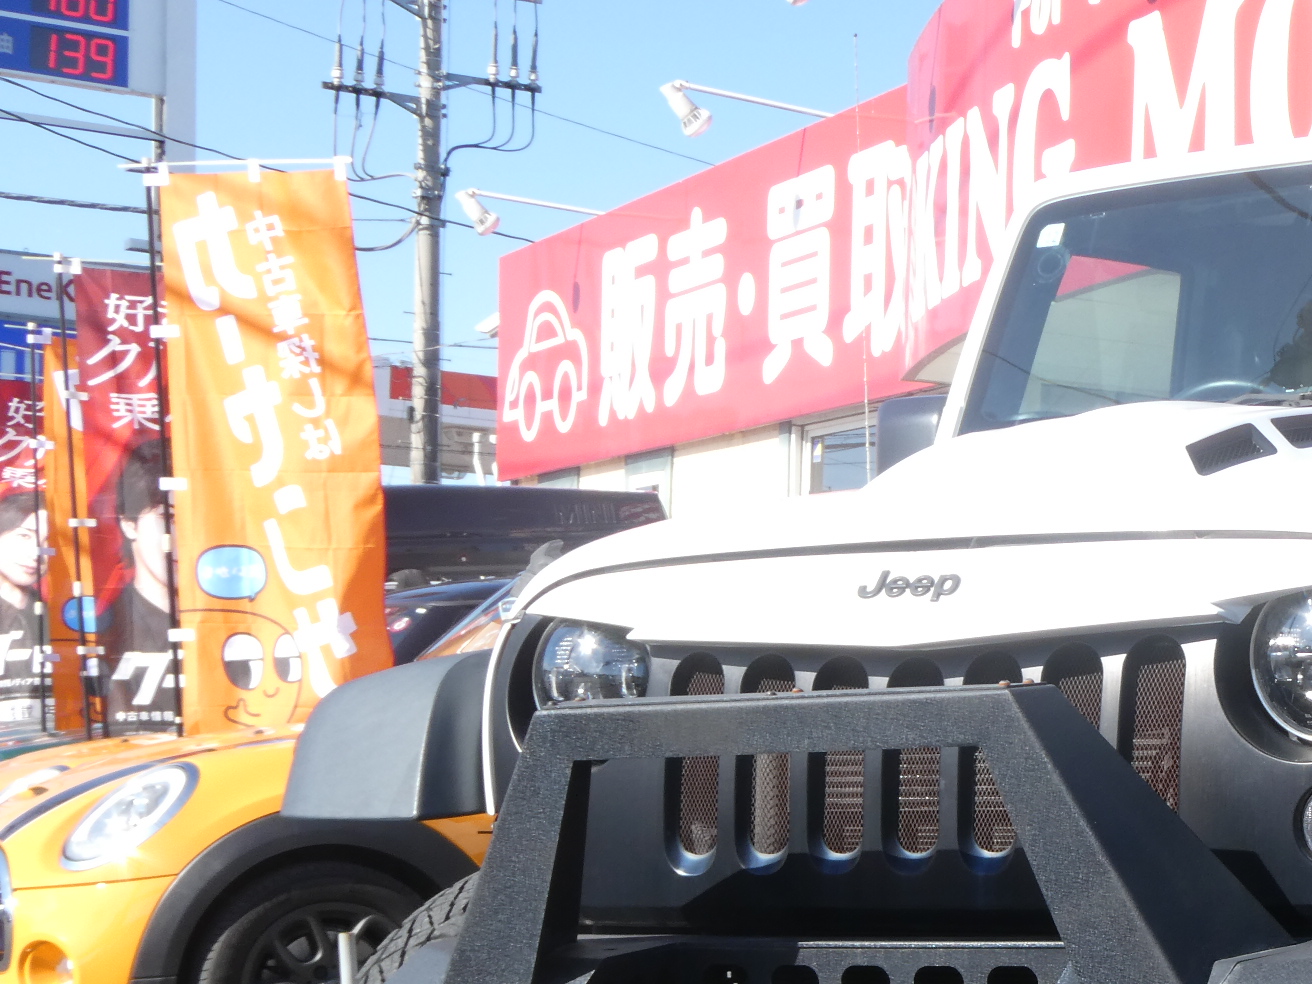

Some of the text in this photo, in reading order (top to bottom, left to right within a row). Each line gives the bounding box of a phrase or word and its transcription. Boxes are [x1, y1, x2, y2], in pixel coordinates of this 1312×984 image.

[48, 33, 116, 80] 139
[908, 51, 1075, 323] KING
[857, 569, 962, 603] Jeep
